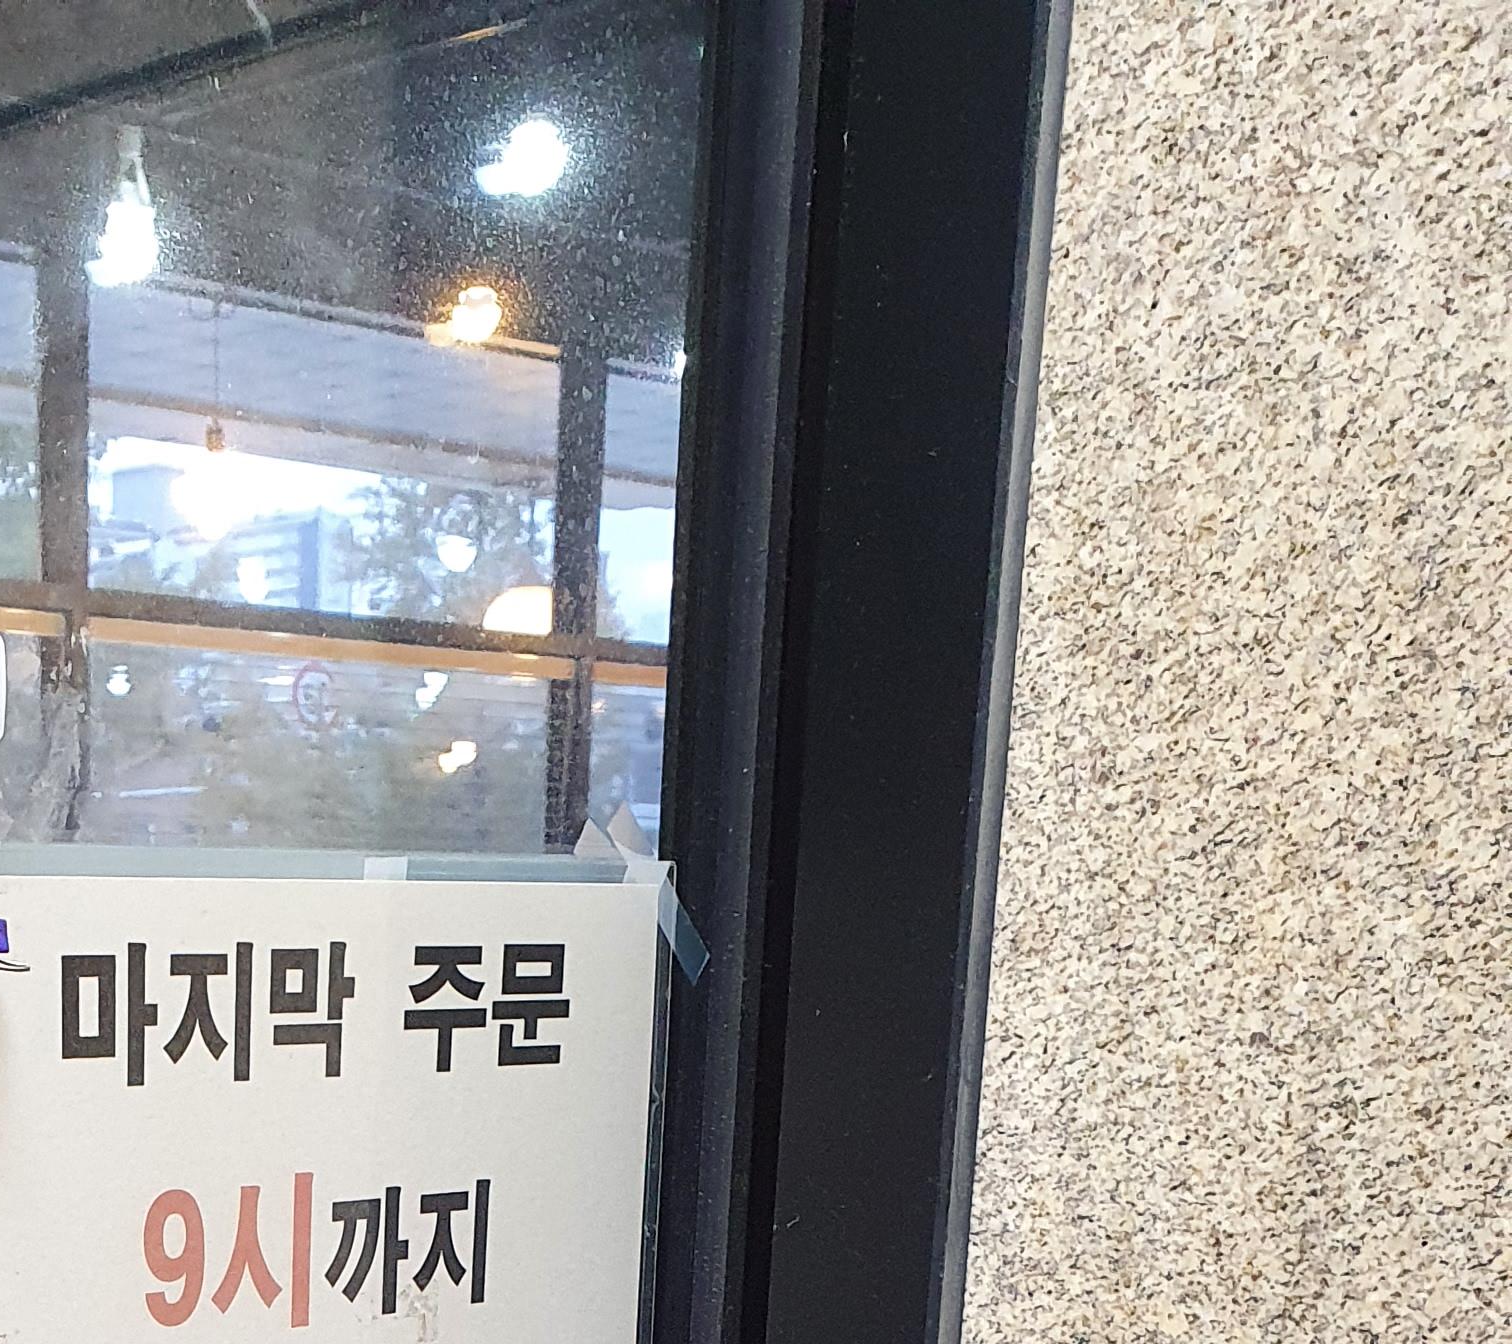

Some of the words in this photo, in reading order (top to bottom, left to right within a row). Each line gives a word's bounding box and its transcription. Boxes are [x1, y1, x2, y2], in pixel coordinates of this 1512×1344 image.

[61, 942, 355, 1086] 마지막
[403, 943, 570, 1073] 주문
[143, 1172, 491, 1328] 9시까지
